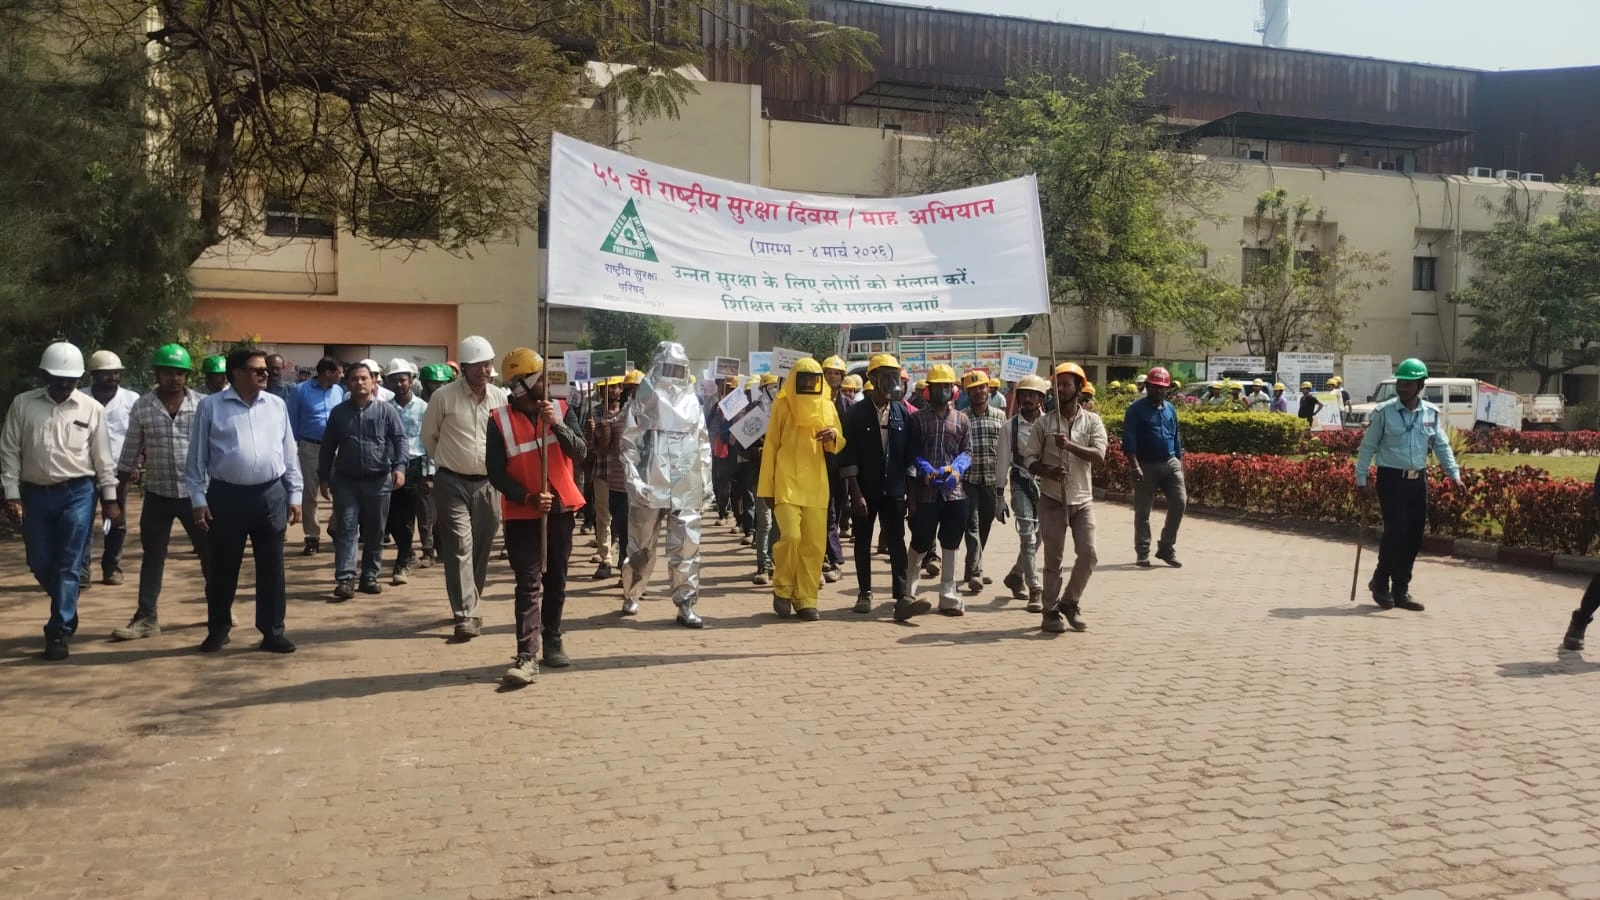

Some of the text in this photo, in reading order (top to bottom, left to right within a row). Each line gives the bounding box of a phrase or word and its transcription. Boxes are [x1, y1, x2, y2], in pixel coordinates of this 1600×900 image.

[593, 161, 622, 191] ५५
[626, 168, 651, 197] वाँ
[657, 182, 720, 215] राष्ट्रीय
[727, 196, 779, 224] सुरक्षा
[787, 201, 838, 225] दिवस
[859, 211, 898, 225] माह
[908, 199, 995, 225] अभियान
[809, 246, 818, 257] ४
[821, 241, 848, 258] मार्च
[604, 263, 658, 282] राष्ट्रीय सुरक्षा
[671, 265, 710, 283] उन्नत
[715, 271, 757, 290] सुरक्षा
[761, 271, 778, 289] के
[785, 273, 821, 294] लिए
[822, 274, 861, 290] लोगों
[865, 274, 887, 289] को
[894, 274, 938, 289] संलग्न
[721, 294, 775, 313] शिक्षित
[779, 298, 804, 313] करें
[811, 298, 839, 313] और
[901, 295, 944, 313] बनाएँ
